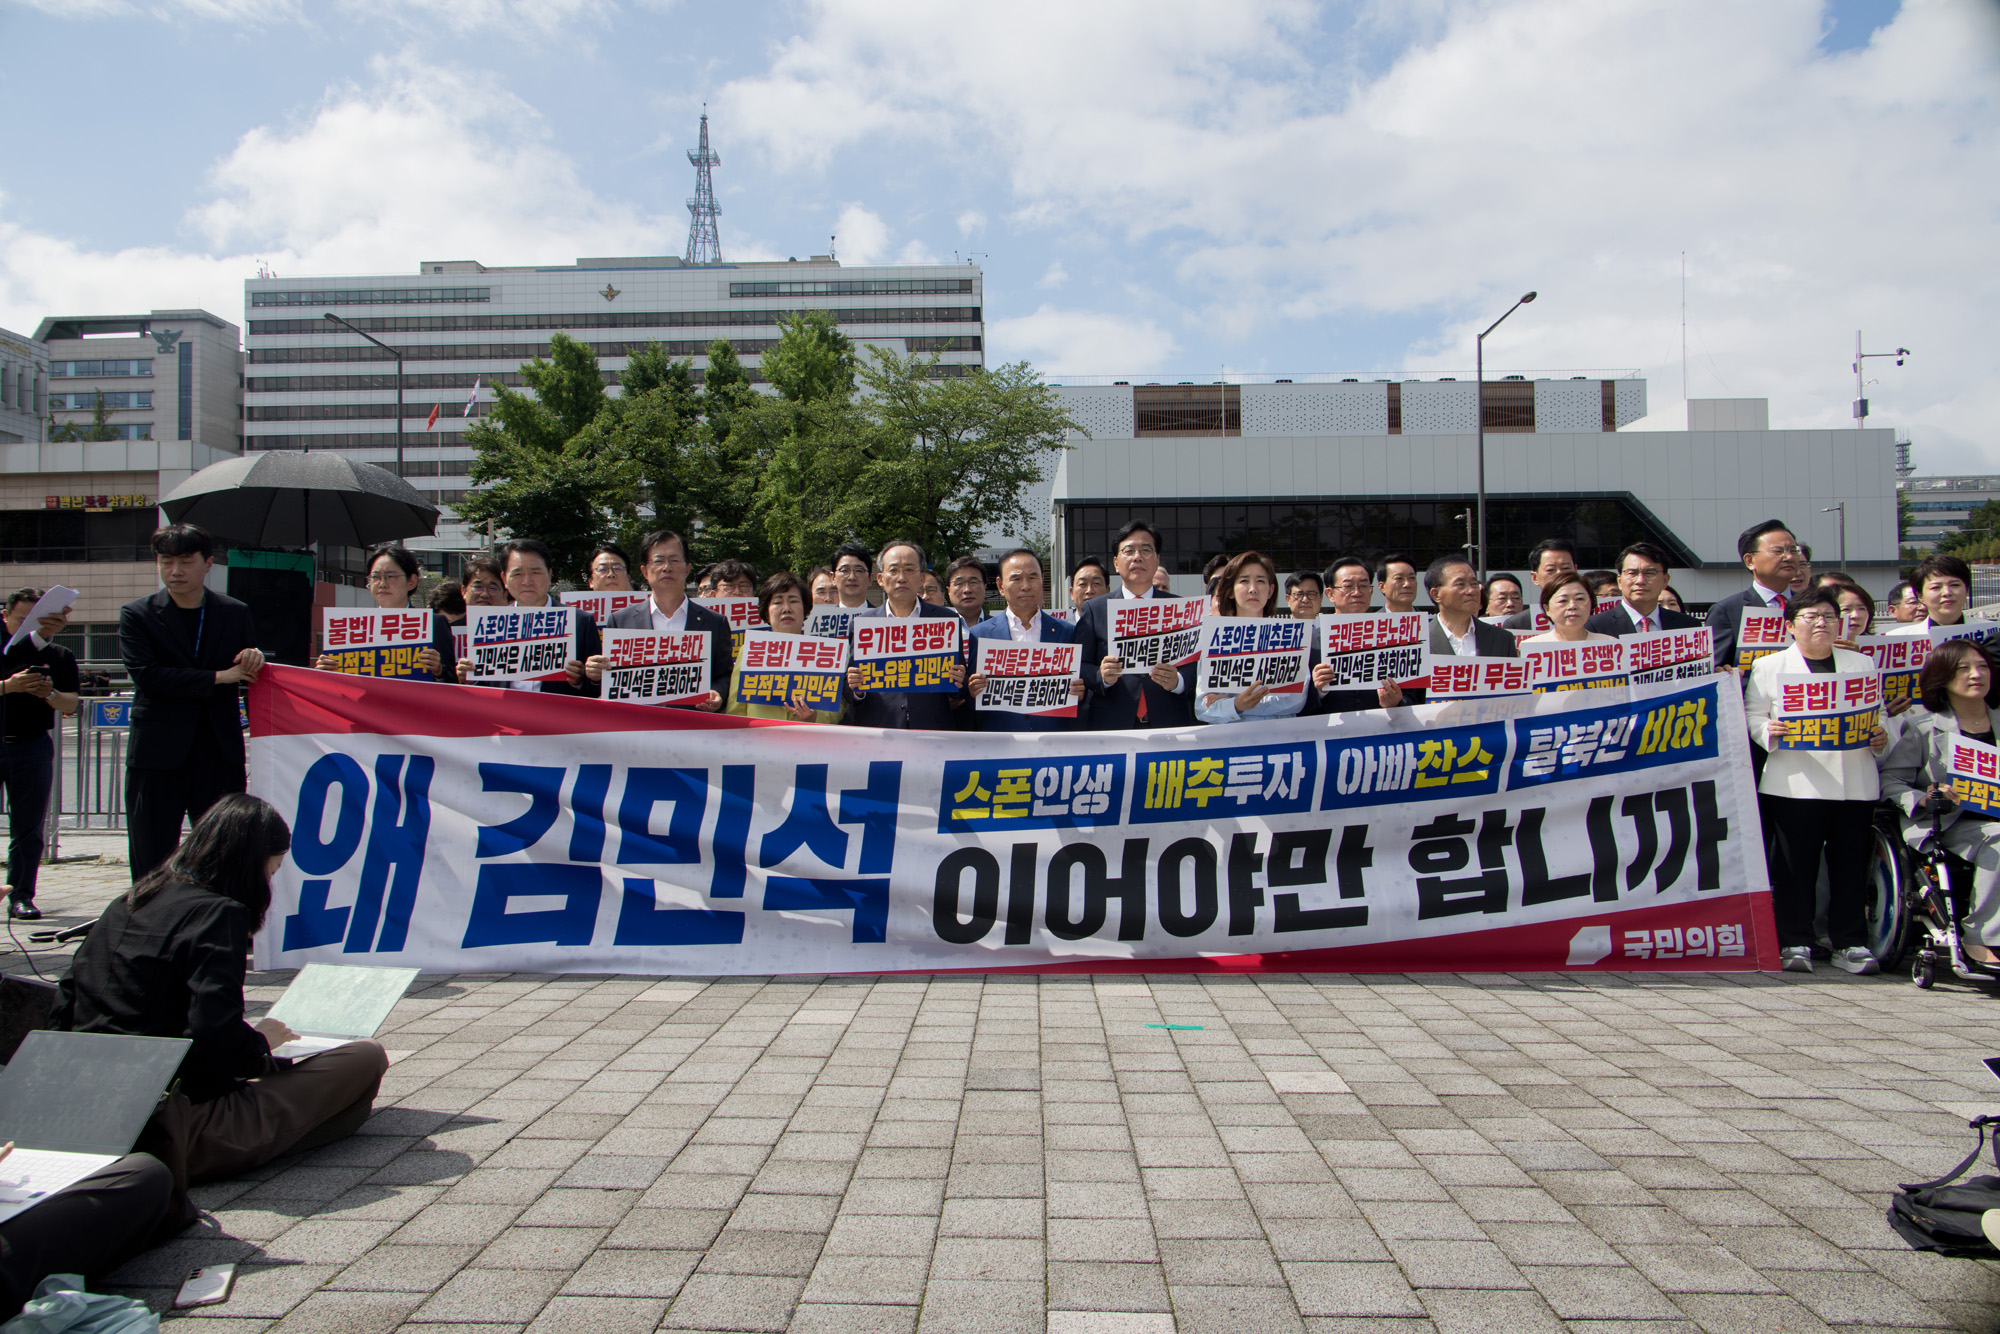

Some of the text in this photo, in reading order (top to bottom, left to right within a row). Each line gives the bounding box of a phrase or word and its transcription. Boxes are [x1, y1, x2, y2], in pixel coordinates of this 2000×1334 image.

[328, 612, 428, 646] 불법! 무능!
[473, 610, 567, 644] 스폰의혹 배추투자
[1115, 599, 1204, 637] 국민들은 분노한다
[1328, 614, 1421, 653] 국민들은 분노한다
[610, 636, 657, 667] 국민들은
[657, 634, 703, 665] 분노한다
[746, 640, 793, 668] 불법!
[796, 641, 844, 668] 무능!
[858, 625, 907, 655] 우기면
[911, 621, 956, 651] 장땡?
[1116, 628, 1201, 669] 김민석을 철회하라
[1208, 622, 1304, 655] 스폰의혹 배추투자
[1630, 637, 1672, 671] 국민들은
[1674, 629, 1709, 663] 분노한다
[474, 645, 520, 676] 김민석은
[520, 642, 567, 673] 사퇴하라
[858, 655, 955, 691] 분노유발 김민석
[984, 648, 1029, 676] 국민들은
[1029, 647, 1074, 676] 분노한다
[1208, 655, 1302, 688] 김민석은 사퇴하라
[1328, 647, 1422, 686] 김민석을 철회하라
[1582, 643, 1623, 674] 장땡?
[608, 666, 702, 699] 김민석을 철회하라
[741, 674, 840, 703] 부적격 김민석
[1026, 678, 1071, 707] 철회하라
[1431, 661, 1530, 693] 불법! 무능!
[1783, 681, 1837, 712] 불법!
[1844, 672, 1880, 707] 무능!
[1783, 717, 1840, 748] 부적격
[951, 763, 1114, 820] 스폰인생
[1144, 751, 1306, 809] 배추투자
[1336, 736, 1494, 795] 아빠찬스
[1522, 713, 1639, 777] 탈북민
[1636, 697, 1708, 755] 비하
[282, 751, 904, 954] 왜 김민석
[932, 779, 1728, 946] 이어야만 합니까
[1623, 923, 1746, 960] 국민의힘
